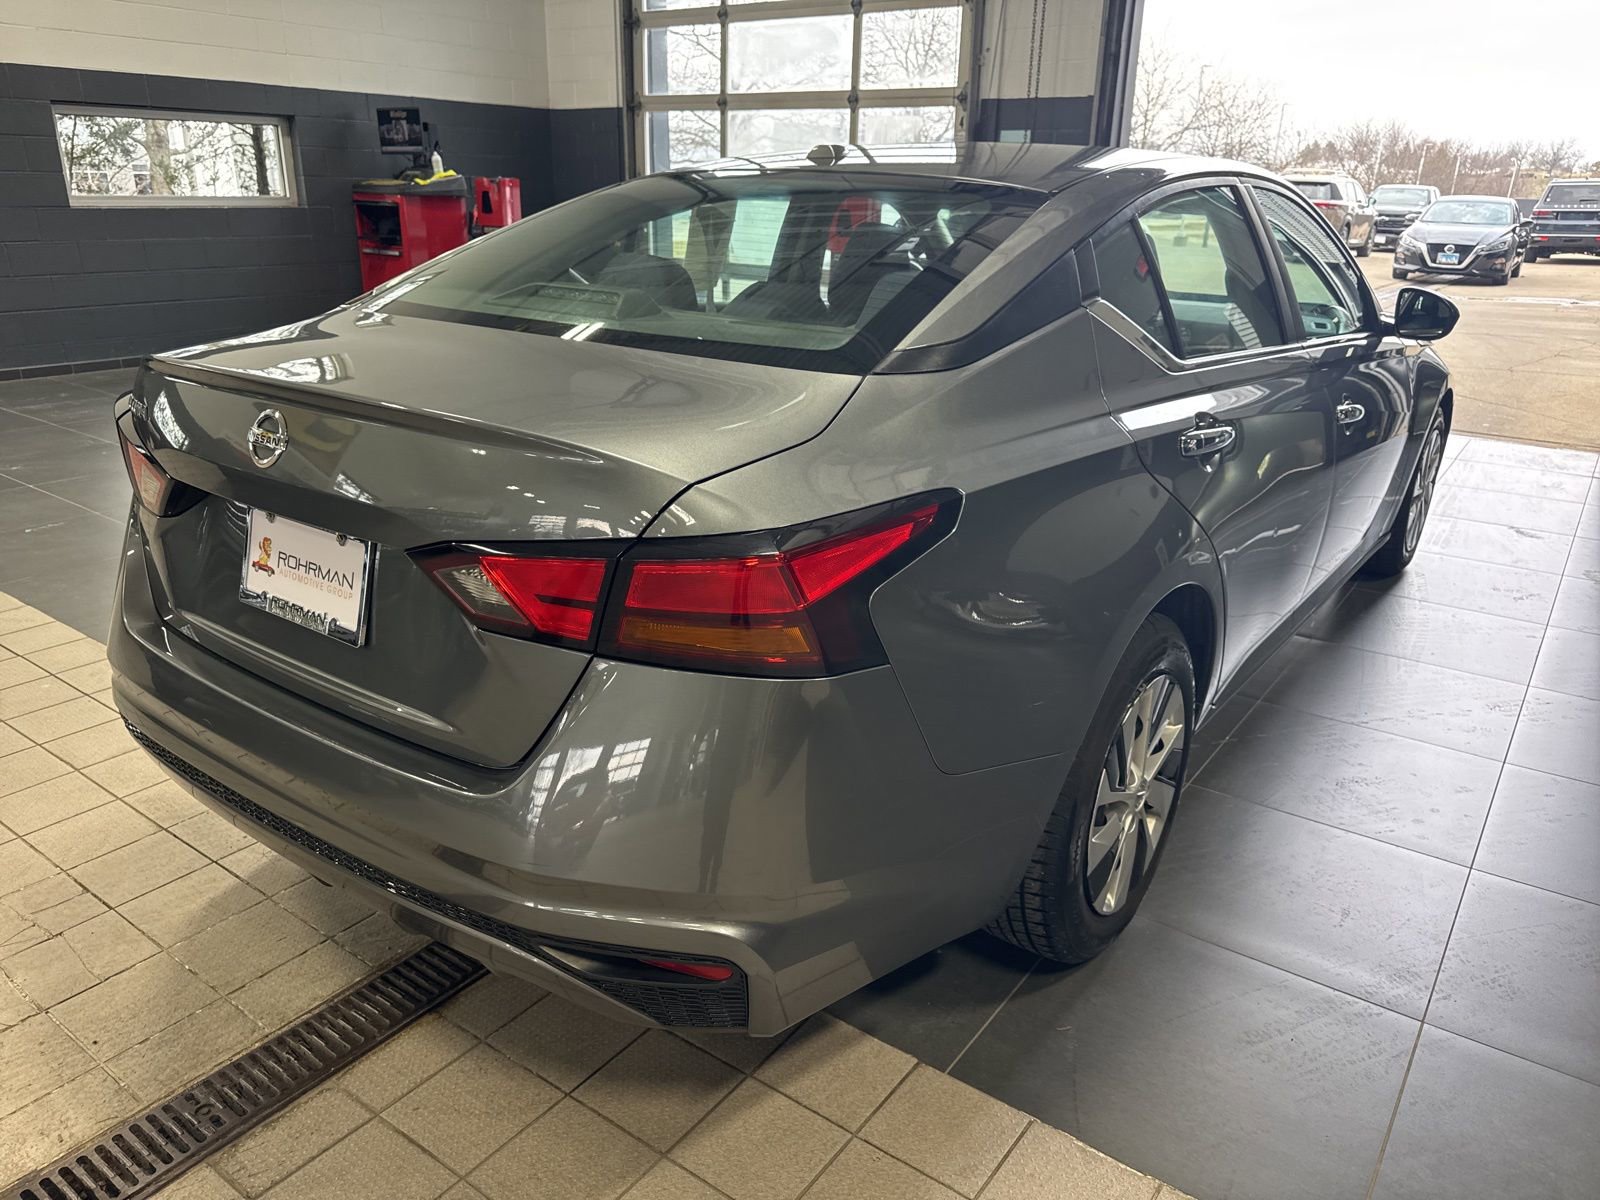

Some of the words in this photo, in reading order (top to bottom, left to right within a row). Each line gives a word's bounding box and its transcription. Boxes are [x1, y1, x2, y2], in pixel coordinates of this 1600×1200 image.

[277, 551, 354, 590] ROHRMAN
[279, 568, 324, 591] AUTOMOTIVE
[326, 584, 353, 600] GROUP
[271, 595, 327, 624] ROHRMAN
